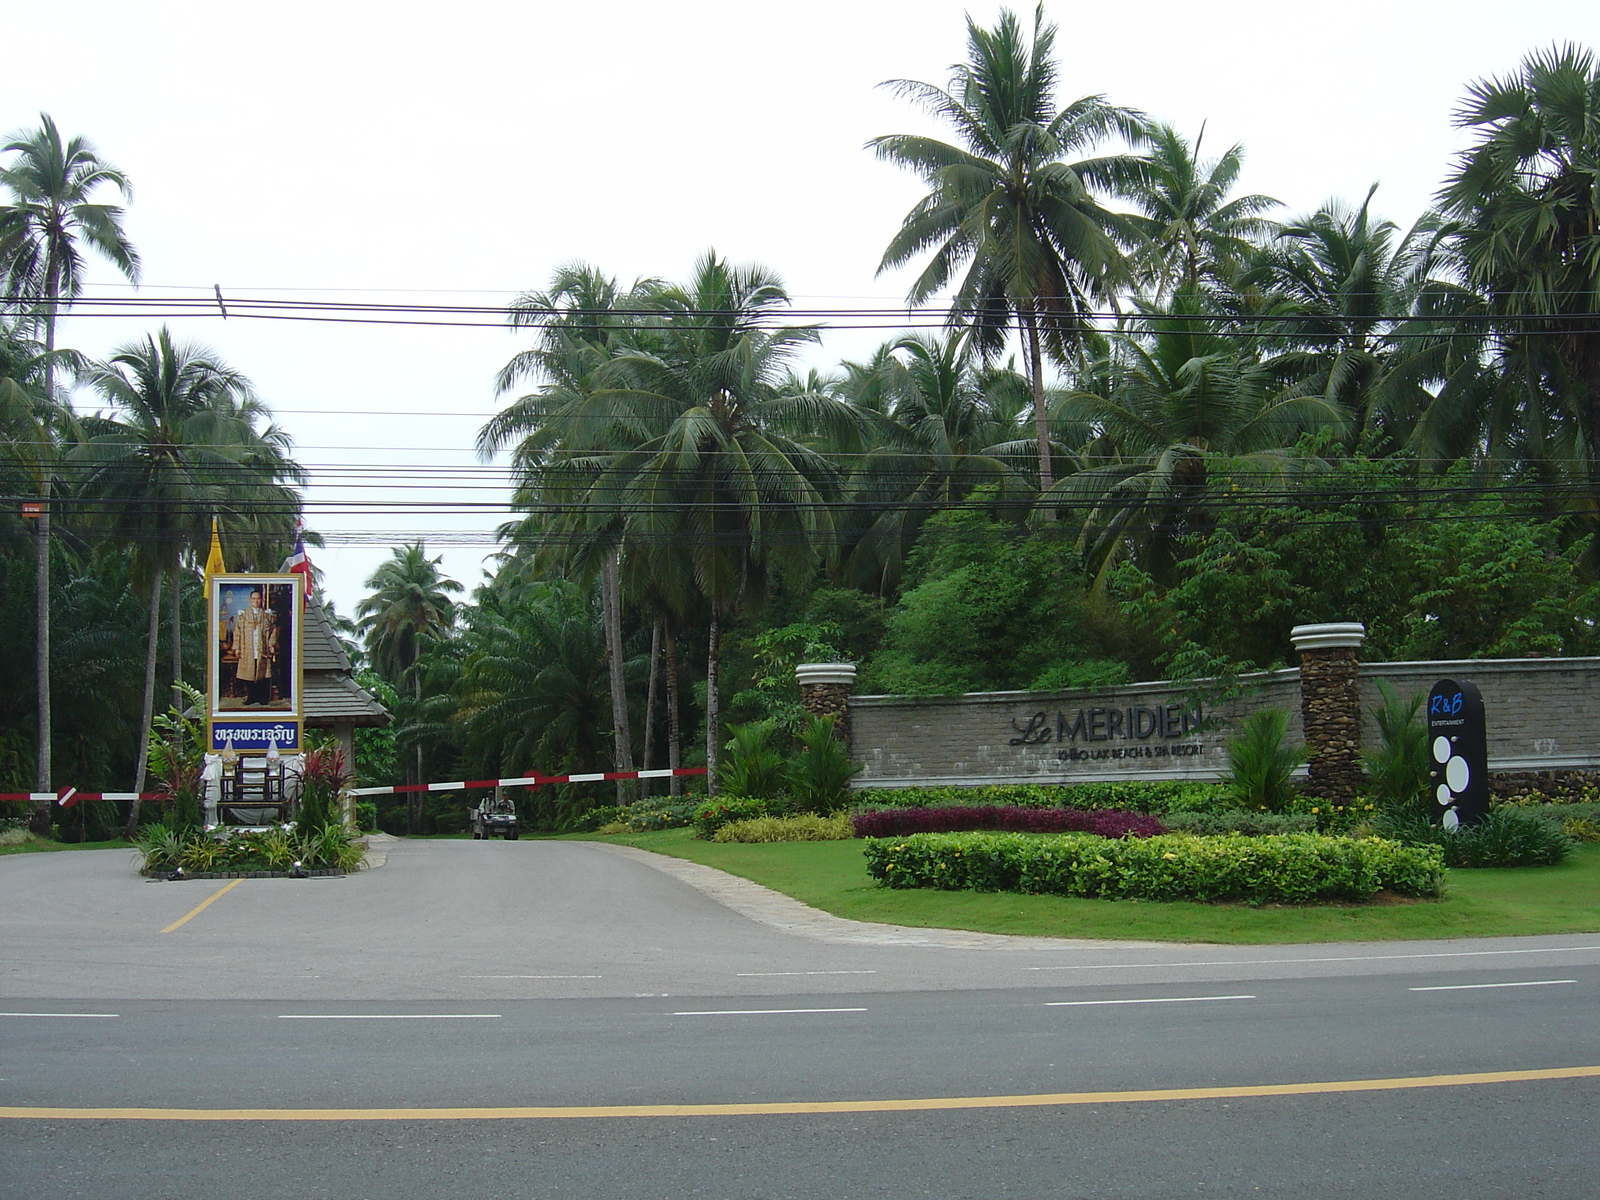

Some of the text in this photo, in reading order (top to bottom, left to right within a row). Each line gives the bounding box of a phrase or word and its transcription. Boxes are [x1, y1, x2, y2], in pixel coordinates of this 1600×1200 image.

[1431, 692, 1463, 716] R&B
[214, 724, 295, 745] ทรงพระเจริญ
[1009, 704, 1202, 745] Le MERIDIEN
[1091, 749, 1110, 760] LAK
[1112, 747, 1143, 760] BEACH
[1145, 746, 1153, 757] &
[1154, 746, 1170, 757] SPA
[1172, 744, 1204, 757] RESORT
